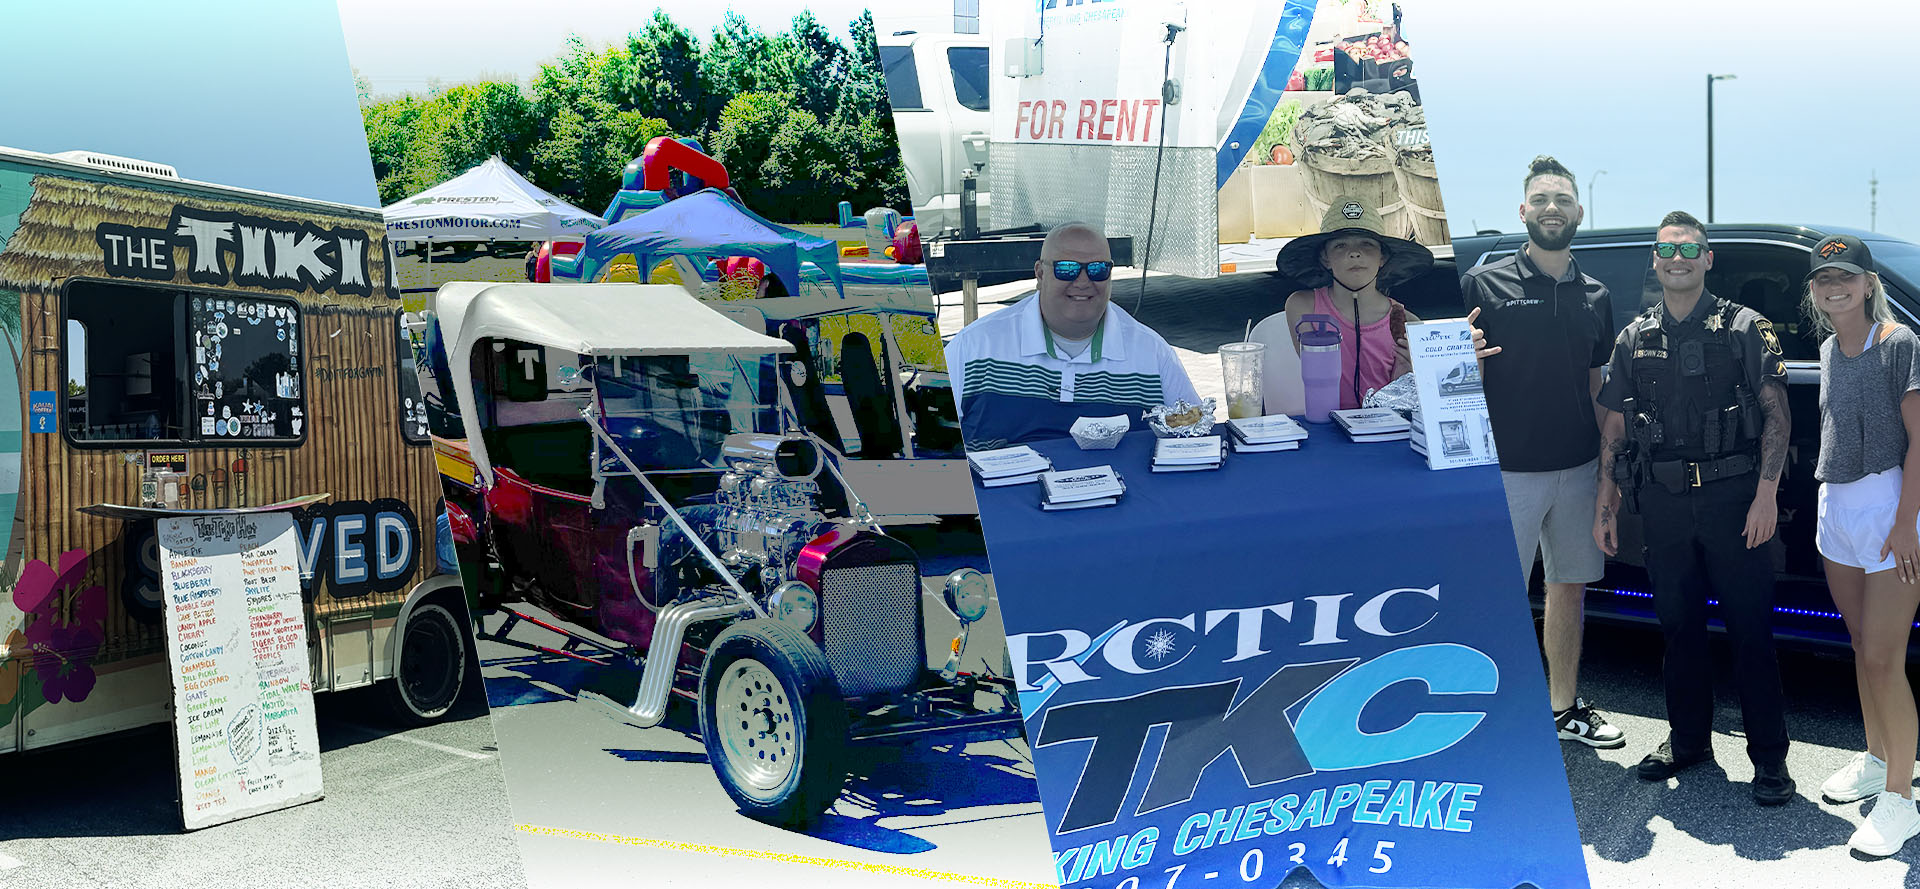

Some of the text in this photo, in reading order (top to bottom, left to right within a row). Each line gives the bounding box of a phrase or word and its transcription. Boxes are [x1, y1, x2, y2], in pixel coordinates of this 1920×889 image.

[1014, 99, 1160, 143] FOR RENT
[1397, 130, 1430, 145] THIS
[386, 217, 520, 230] PRESTONMOTOR.COM
[105, 216, 367, 288] THE TIKI
[151, 454, 185, 463] ORDER HERE
[170, 558, 198, 569] BANANA
[171, 565, 212, 581] BLACKBERRY
[176, 599, 214, 612] BUBBLE GUM
[177, 617, 216, 633] CANDY APPLE
[178, 629, 204, 642] CHERRY
[252, 637, 275, 648] TIGERS
[205, 646, 223, 657] CANDY
[254, 652, 281, 661] TROPICS
[184, 675, 229, 691] EGG CUSTARD
[282, 683, 299, 693] WAVE
[186, 690, 208, 701] GRAPE
[262, 700, 285, 710] MOJITO
[188, 706, 224, 724] ICE CREAM
[264, 707, 299, 721] MARGARITA
[1036, 643, 1499, 835] TKC
[194, 766, 217, 778] MANGO
[1173, 780, 1483, 858] CHESAPEAKE
